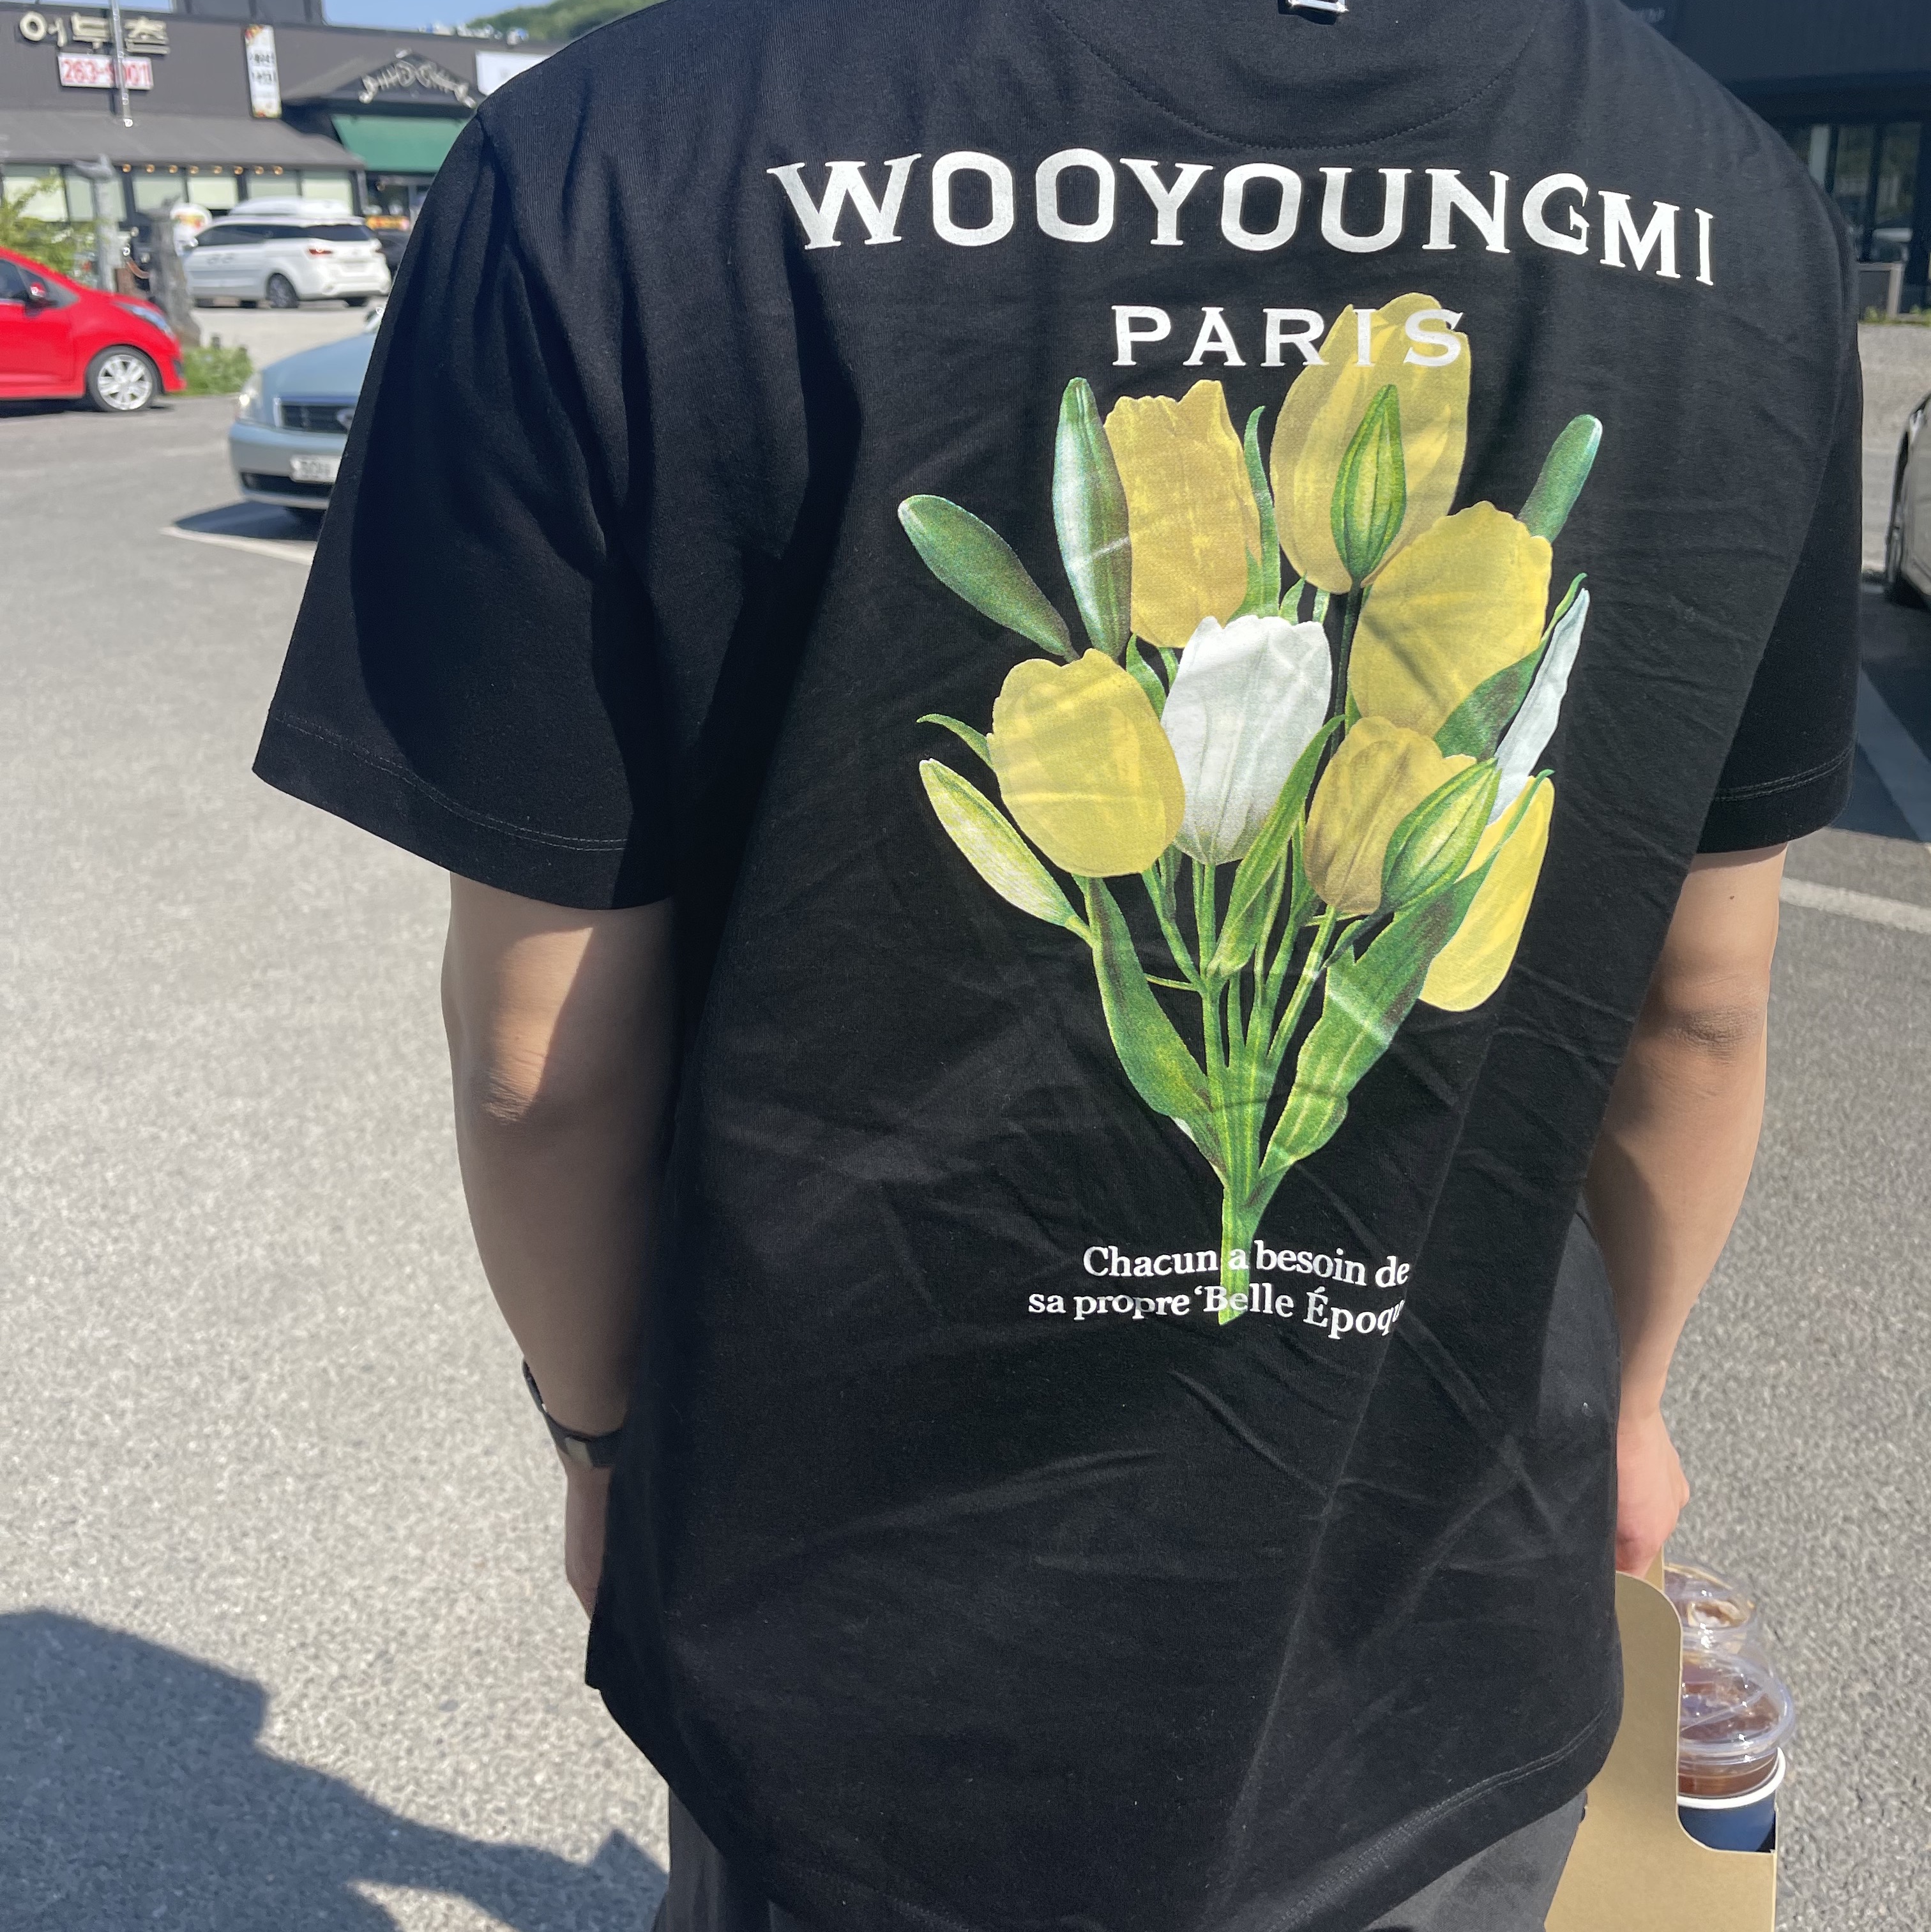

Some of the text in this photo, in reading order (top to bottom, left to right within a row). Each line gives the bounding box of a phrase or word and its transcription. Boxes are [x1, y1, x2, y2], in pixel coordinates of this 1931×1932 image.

[766, 148, 1714, 285] WOOYOUNGMI
[1111, 305, 1464, 368] PARIS
[1083, 1239, 1411, 1288] Chacun a besoin de
[1028, 1293, 1066, 1314] sa
[1073, 1294, 1190, 1321] propre
